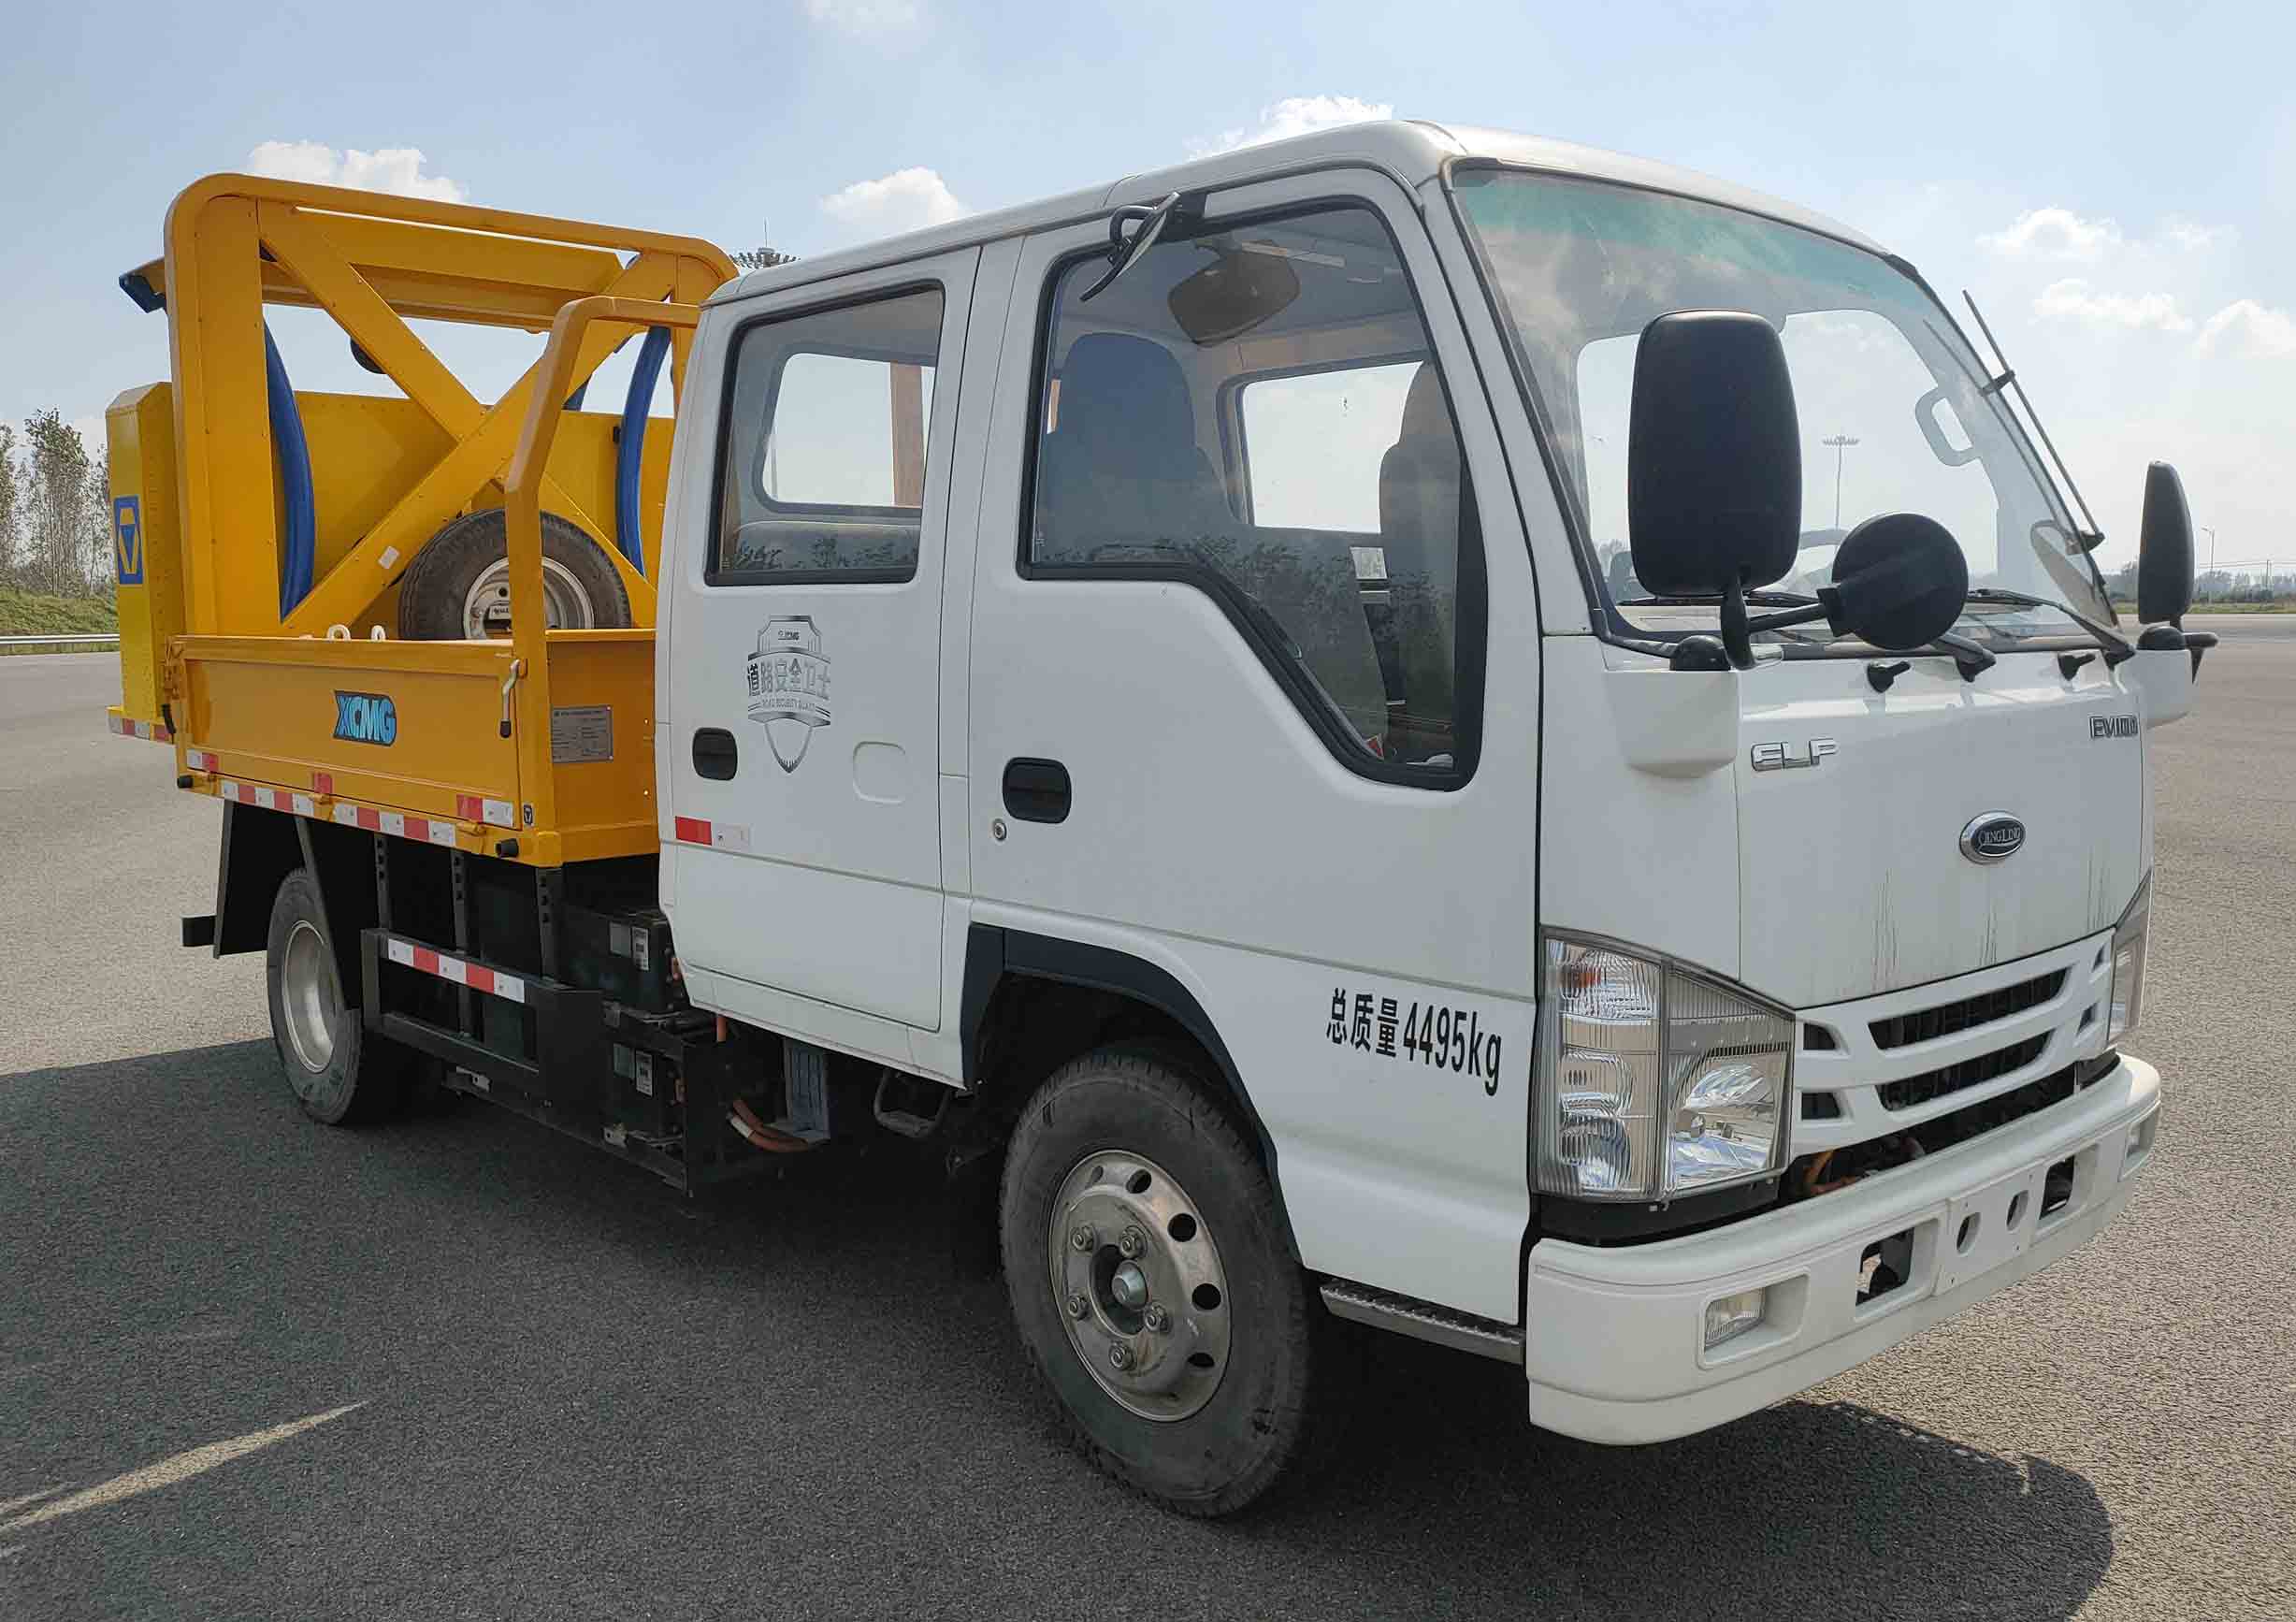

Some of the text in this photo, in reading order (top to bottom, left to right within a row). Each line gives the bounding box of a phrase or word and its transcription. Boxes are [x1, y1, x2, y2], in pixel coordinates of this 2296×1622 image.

[747, 658, 830, 701] 道路安全卫士
[337, 694, 397, 745] XCMG
[1326, 987, 1502, 1096] 总质量4495kg
